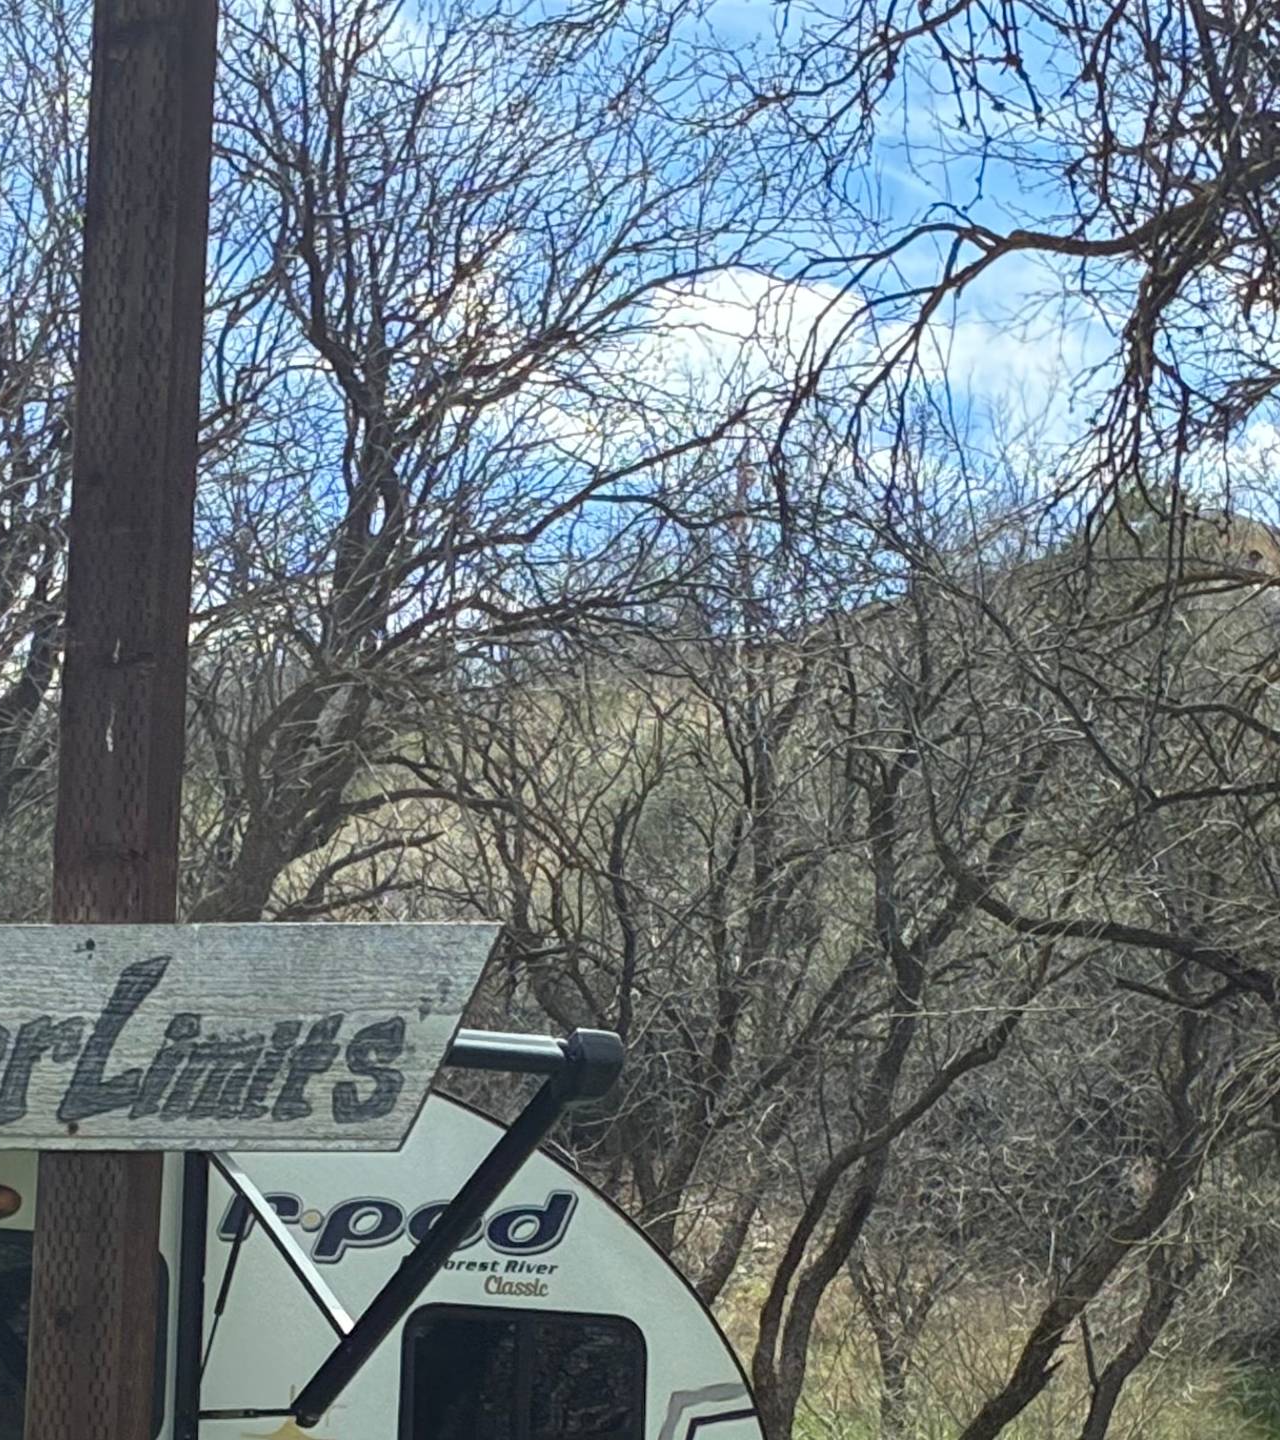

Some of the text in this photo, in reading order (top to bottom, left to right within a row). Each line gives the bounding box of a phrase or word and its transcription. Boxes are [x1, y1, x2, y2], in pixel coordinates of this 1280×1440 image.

[443, 1260, 559, 1275] orest River
[484, 1275, 550, 1297] Classic
